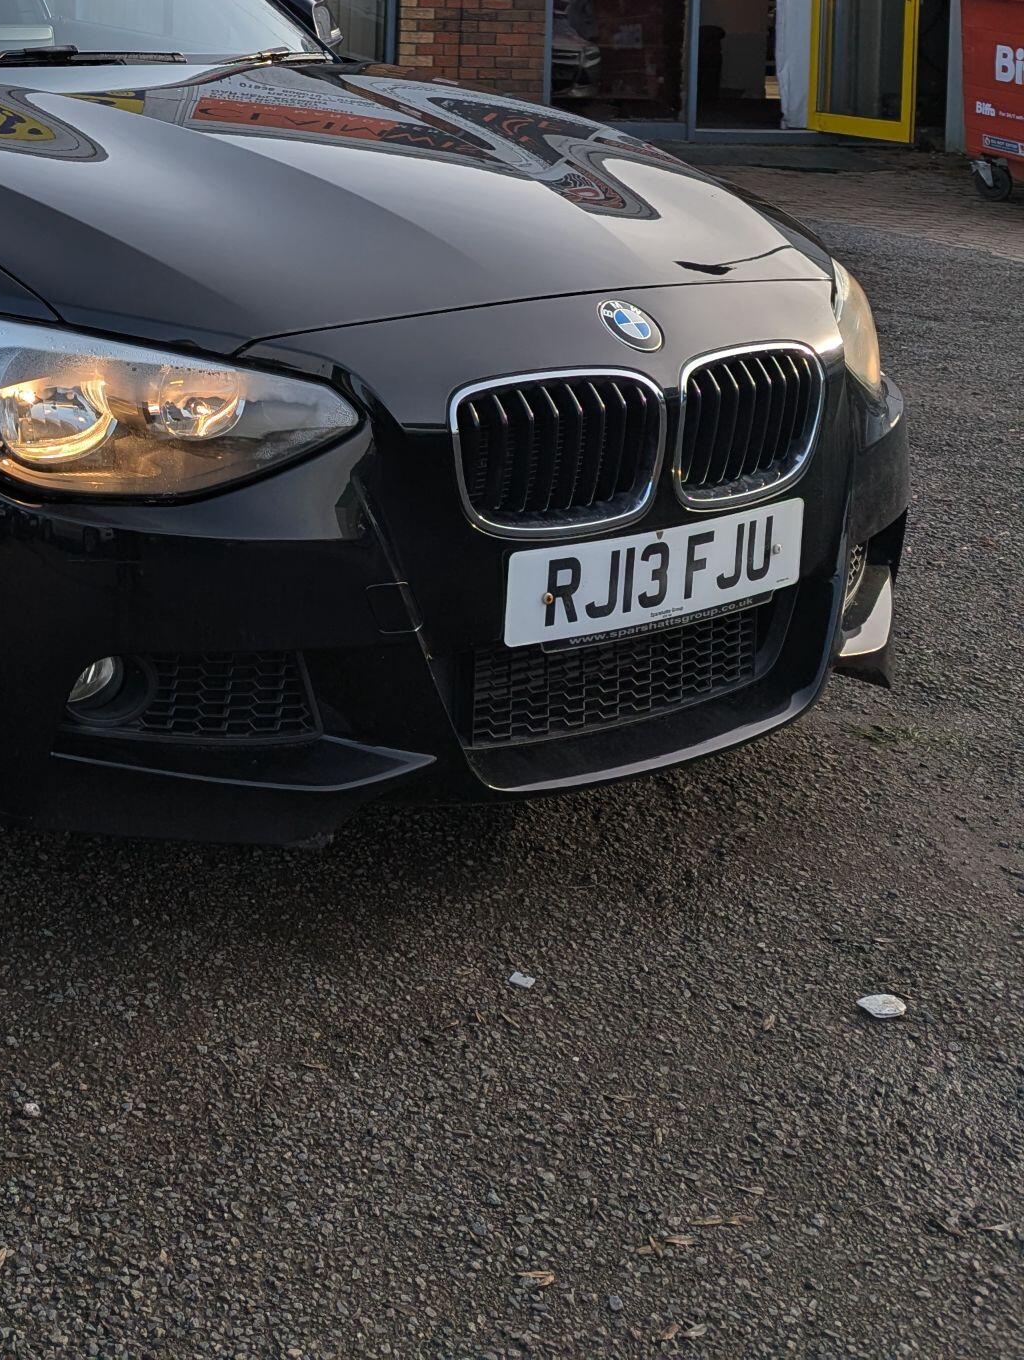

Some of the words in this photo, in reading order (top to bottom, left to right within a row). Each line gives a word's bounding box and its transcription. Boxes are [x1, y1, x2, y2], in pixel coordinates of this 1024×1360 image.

[544, 541, 670, 627] RJ13
[684, 515, 774, 600] FJU
[570, 597, 753, 645] www.sparshattsgroup.co.uk
